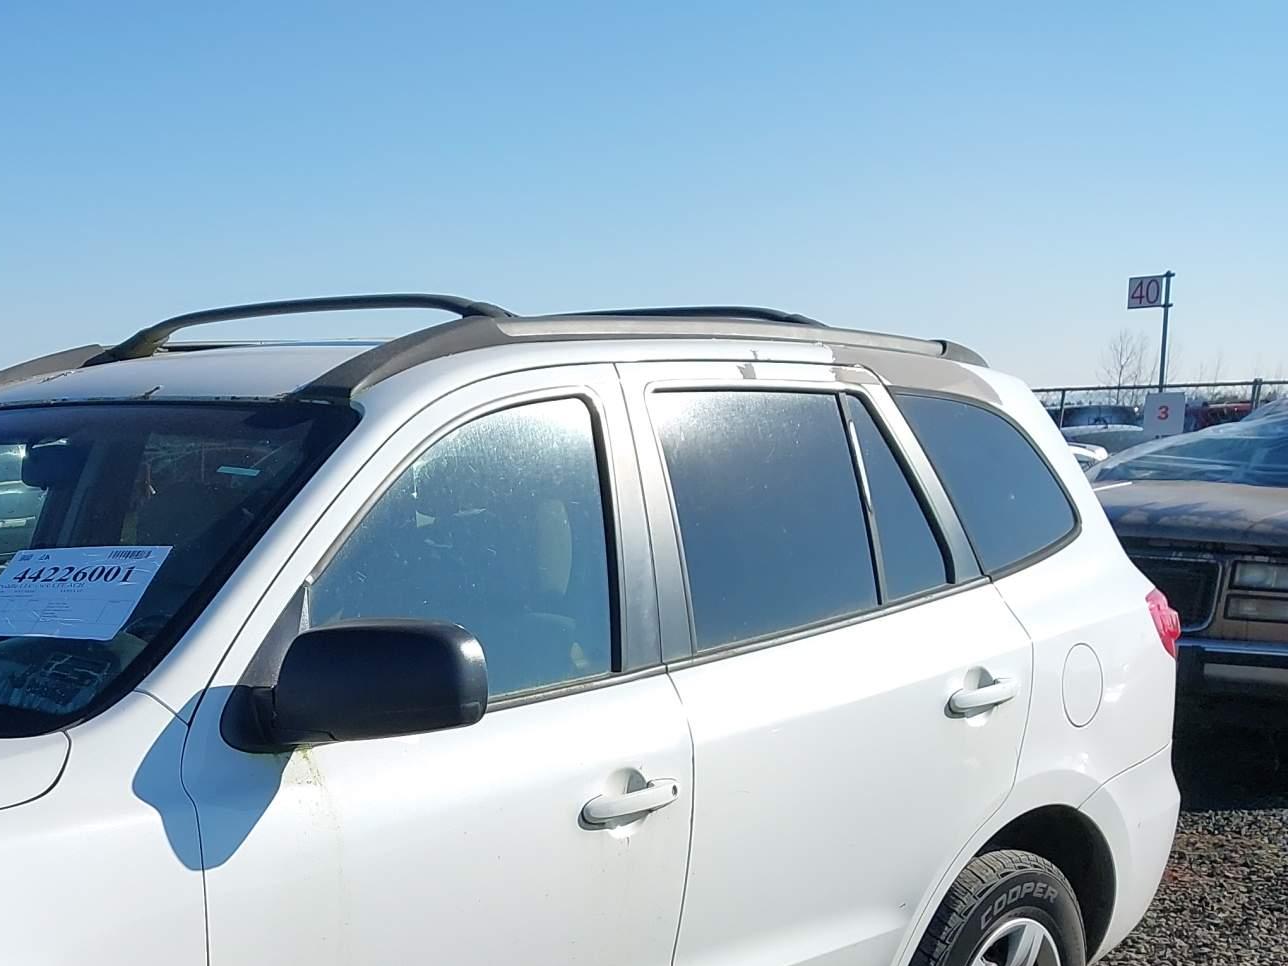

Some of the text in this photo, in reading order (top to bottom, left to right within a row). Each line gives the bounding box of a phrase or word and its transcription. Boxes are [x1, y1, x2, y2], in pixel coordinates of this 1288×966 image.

[1130, 279, 1160, 305] 40
[1157, 405, 1169, 421] 3
[13, 565, 136, 583] 44226001
[980, 881, 1058, 930] COOPER
